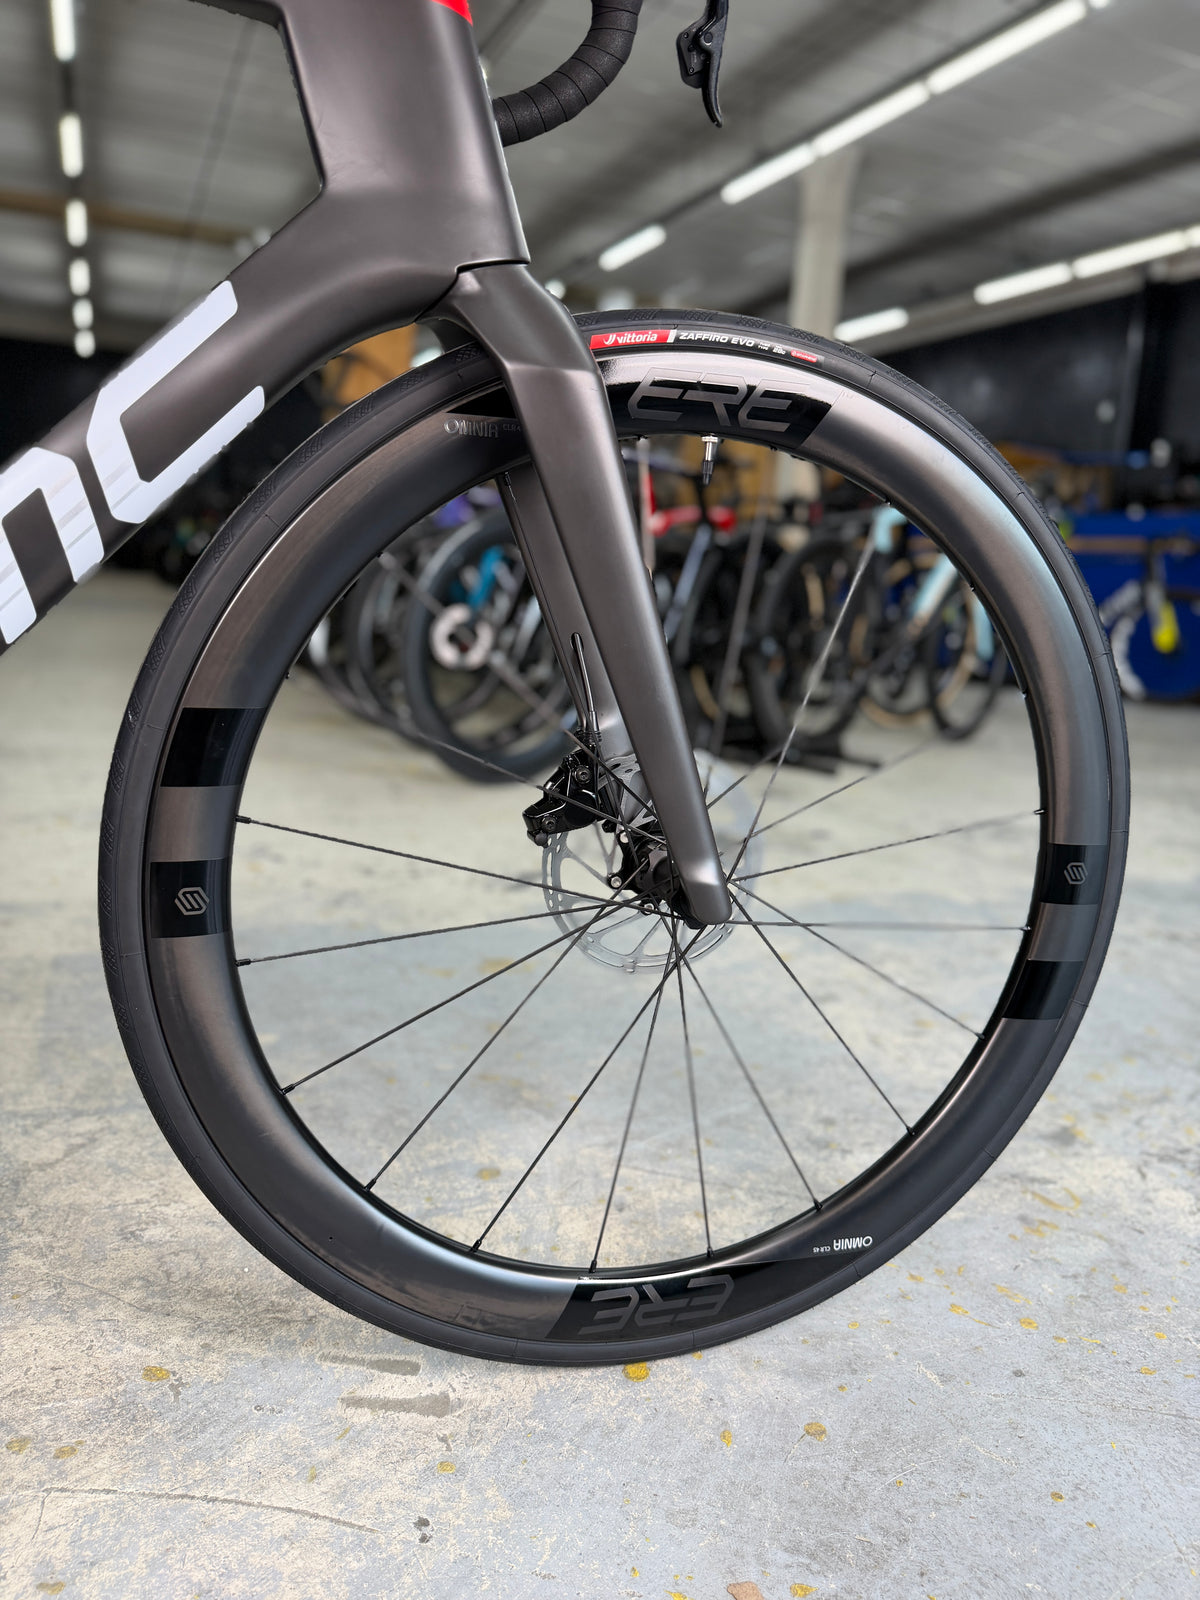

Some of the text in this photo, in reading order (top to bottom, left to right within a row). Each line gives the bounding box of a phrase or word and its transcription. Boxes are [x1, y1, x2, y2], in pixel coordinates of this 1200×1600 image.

[616, 332, 658, 344] vittoria
[679, 332, 729, 343] ZAFFIRO
[731, 337, 755, 347] EVO
[628, 367, 811, 432] ERE
[833, 1235, 873, 1251] OMNIA
[577, 1274, 735, 1335] ERE
